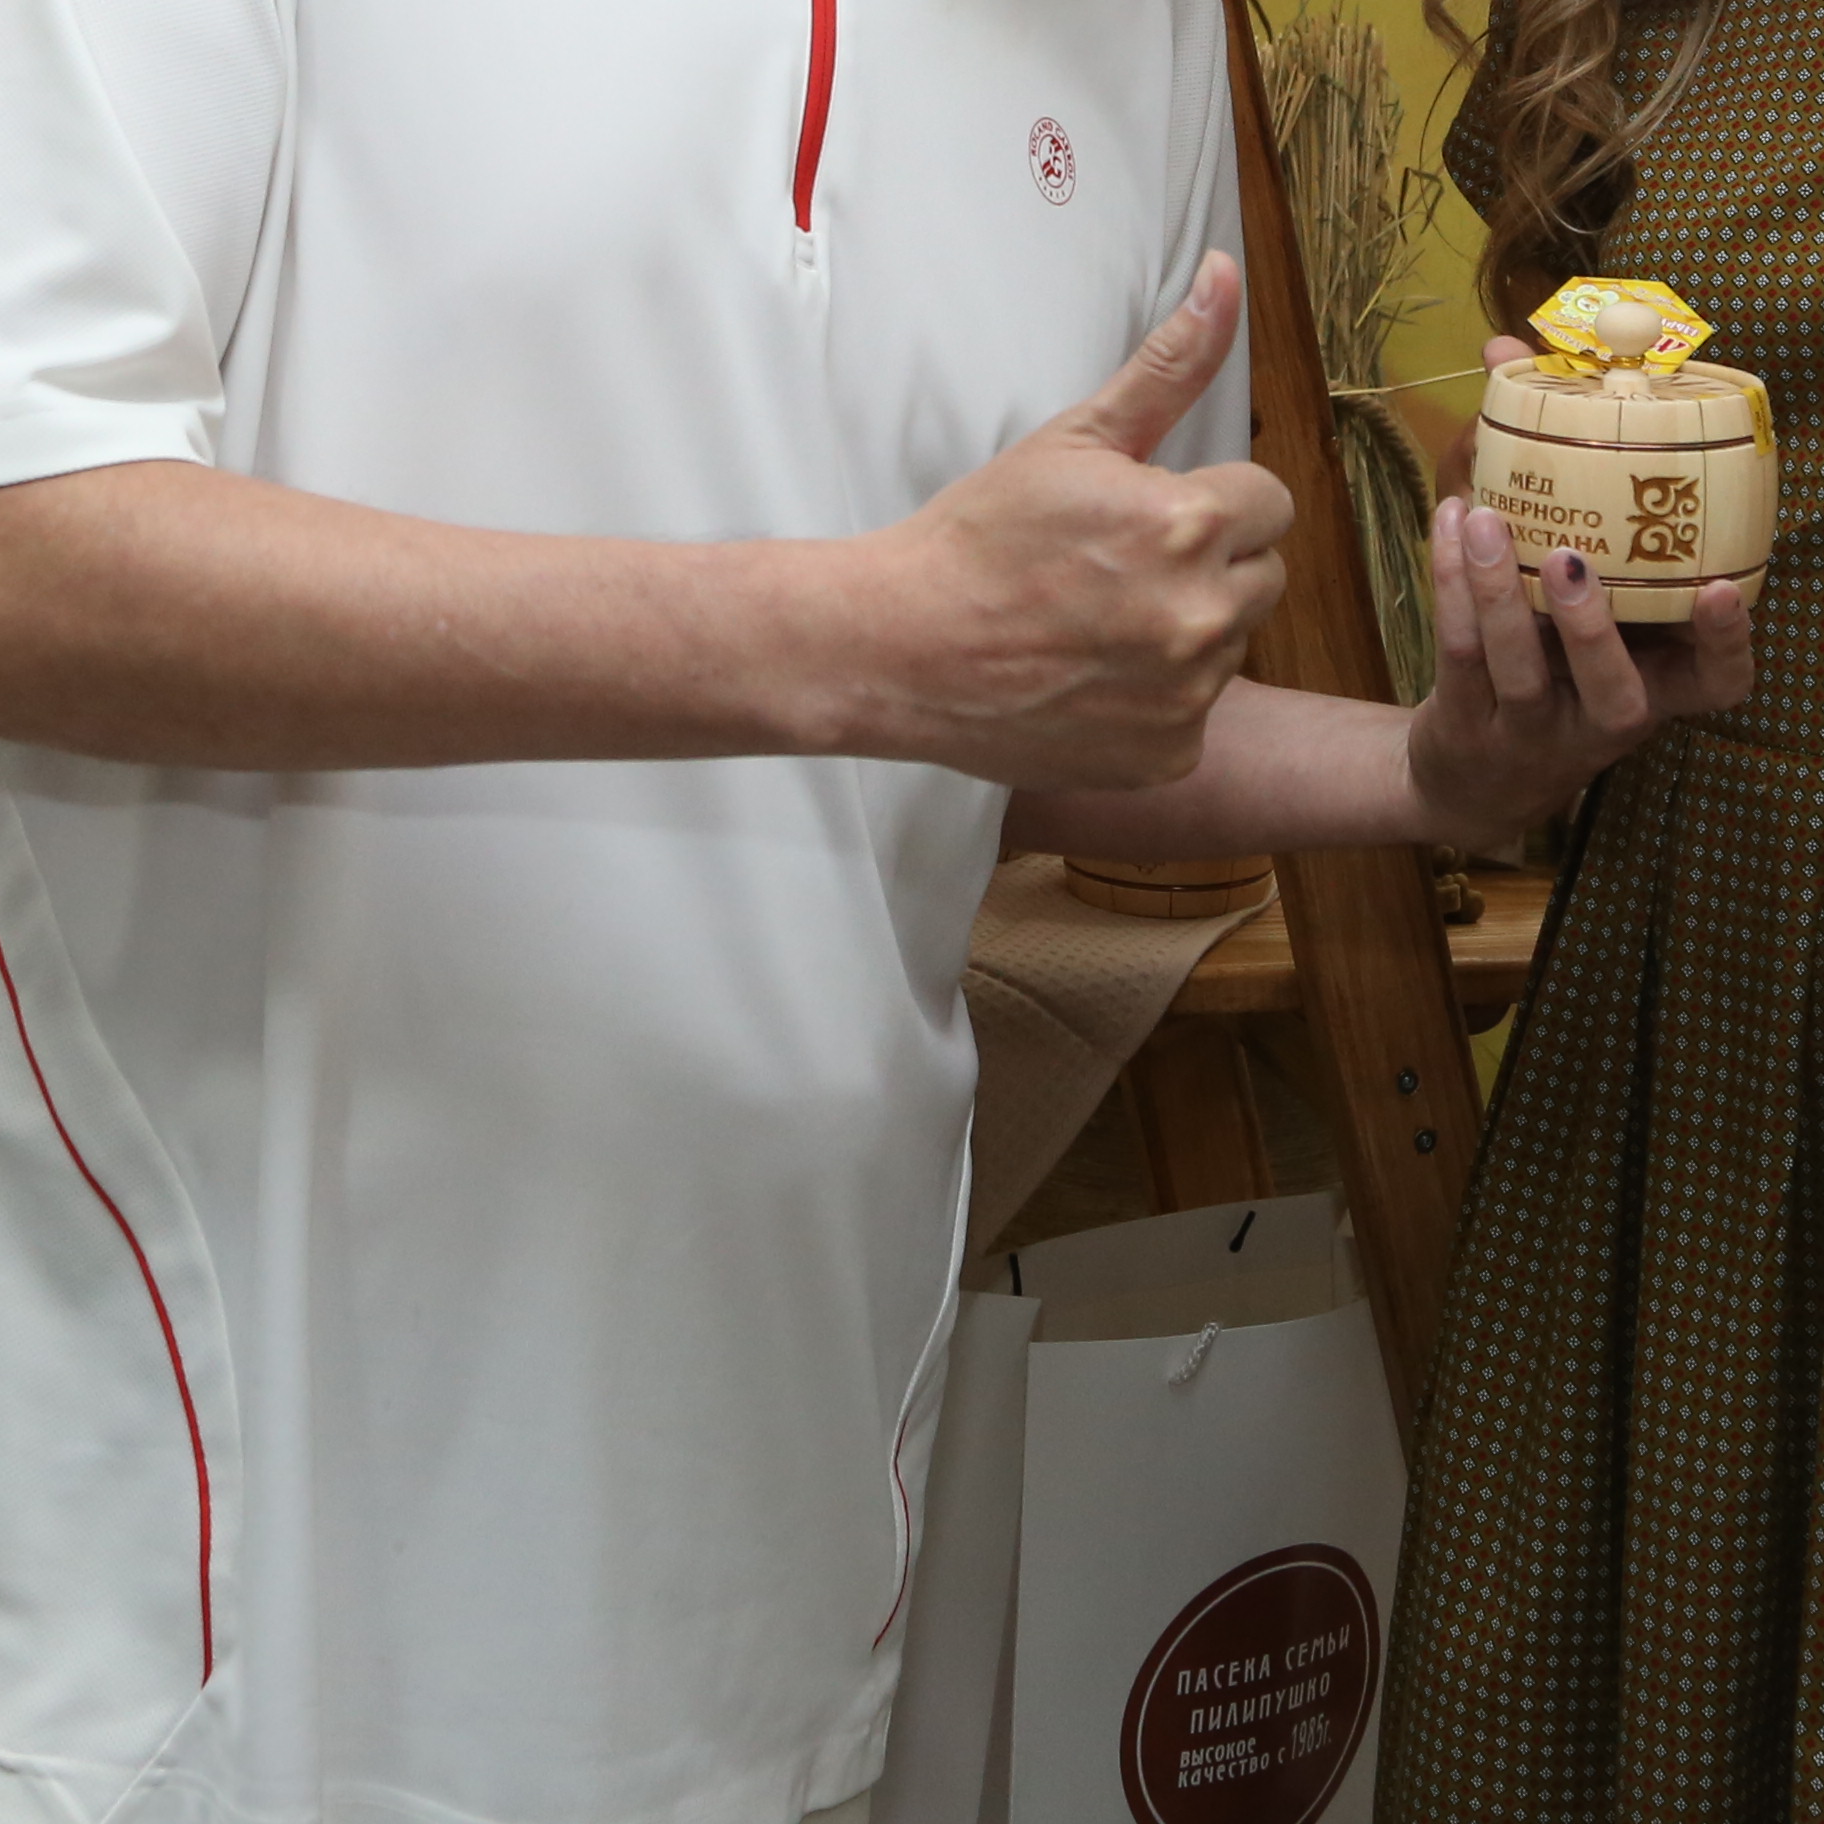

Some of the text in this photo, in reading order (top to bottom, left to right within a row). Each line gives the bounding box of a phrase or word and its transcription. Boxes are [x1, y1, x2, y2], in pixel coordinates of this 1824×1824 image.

[1480, 486, 1603, 528] СЕВЕРНОГО
[1508, 470, 1555, 497] МЁД
[1177, 1624, 1350, 1696] ПАСЕКА СЕМЬИ
[1190, 1671, 1331, 1735] ПИЛИПУШКО
